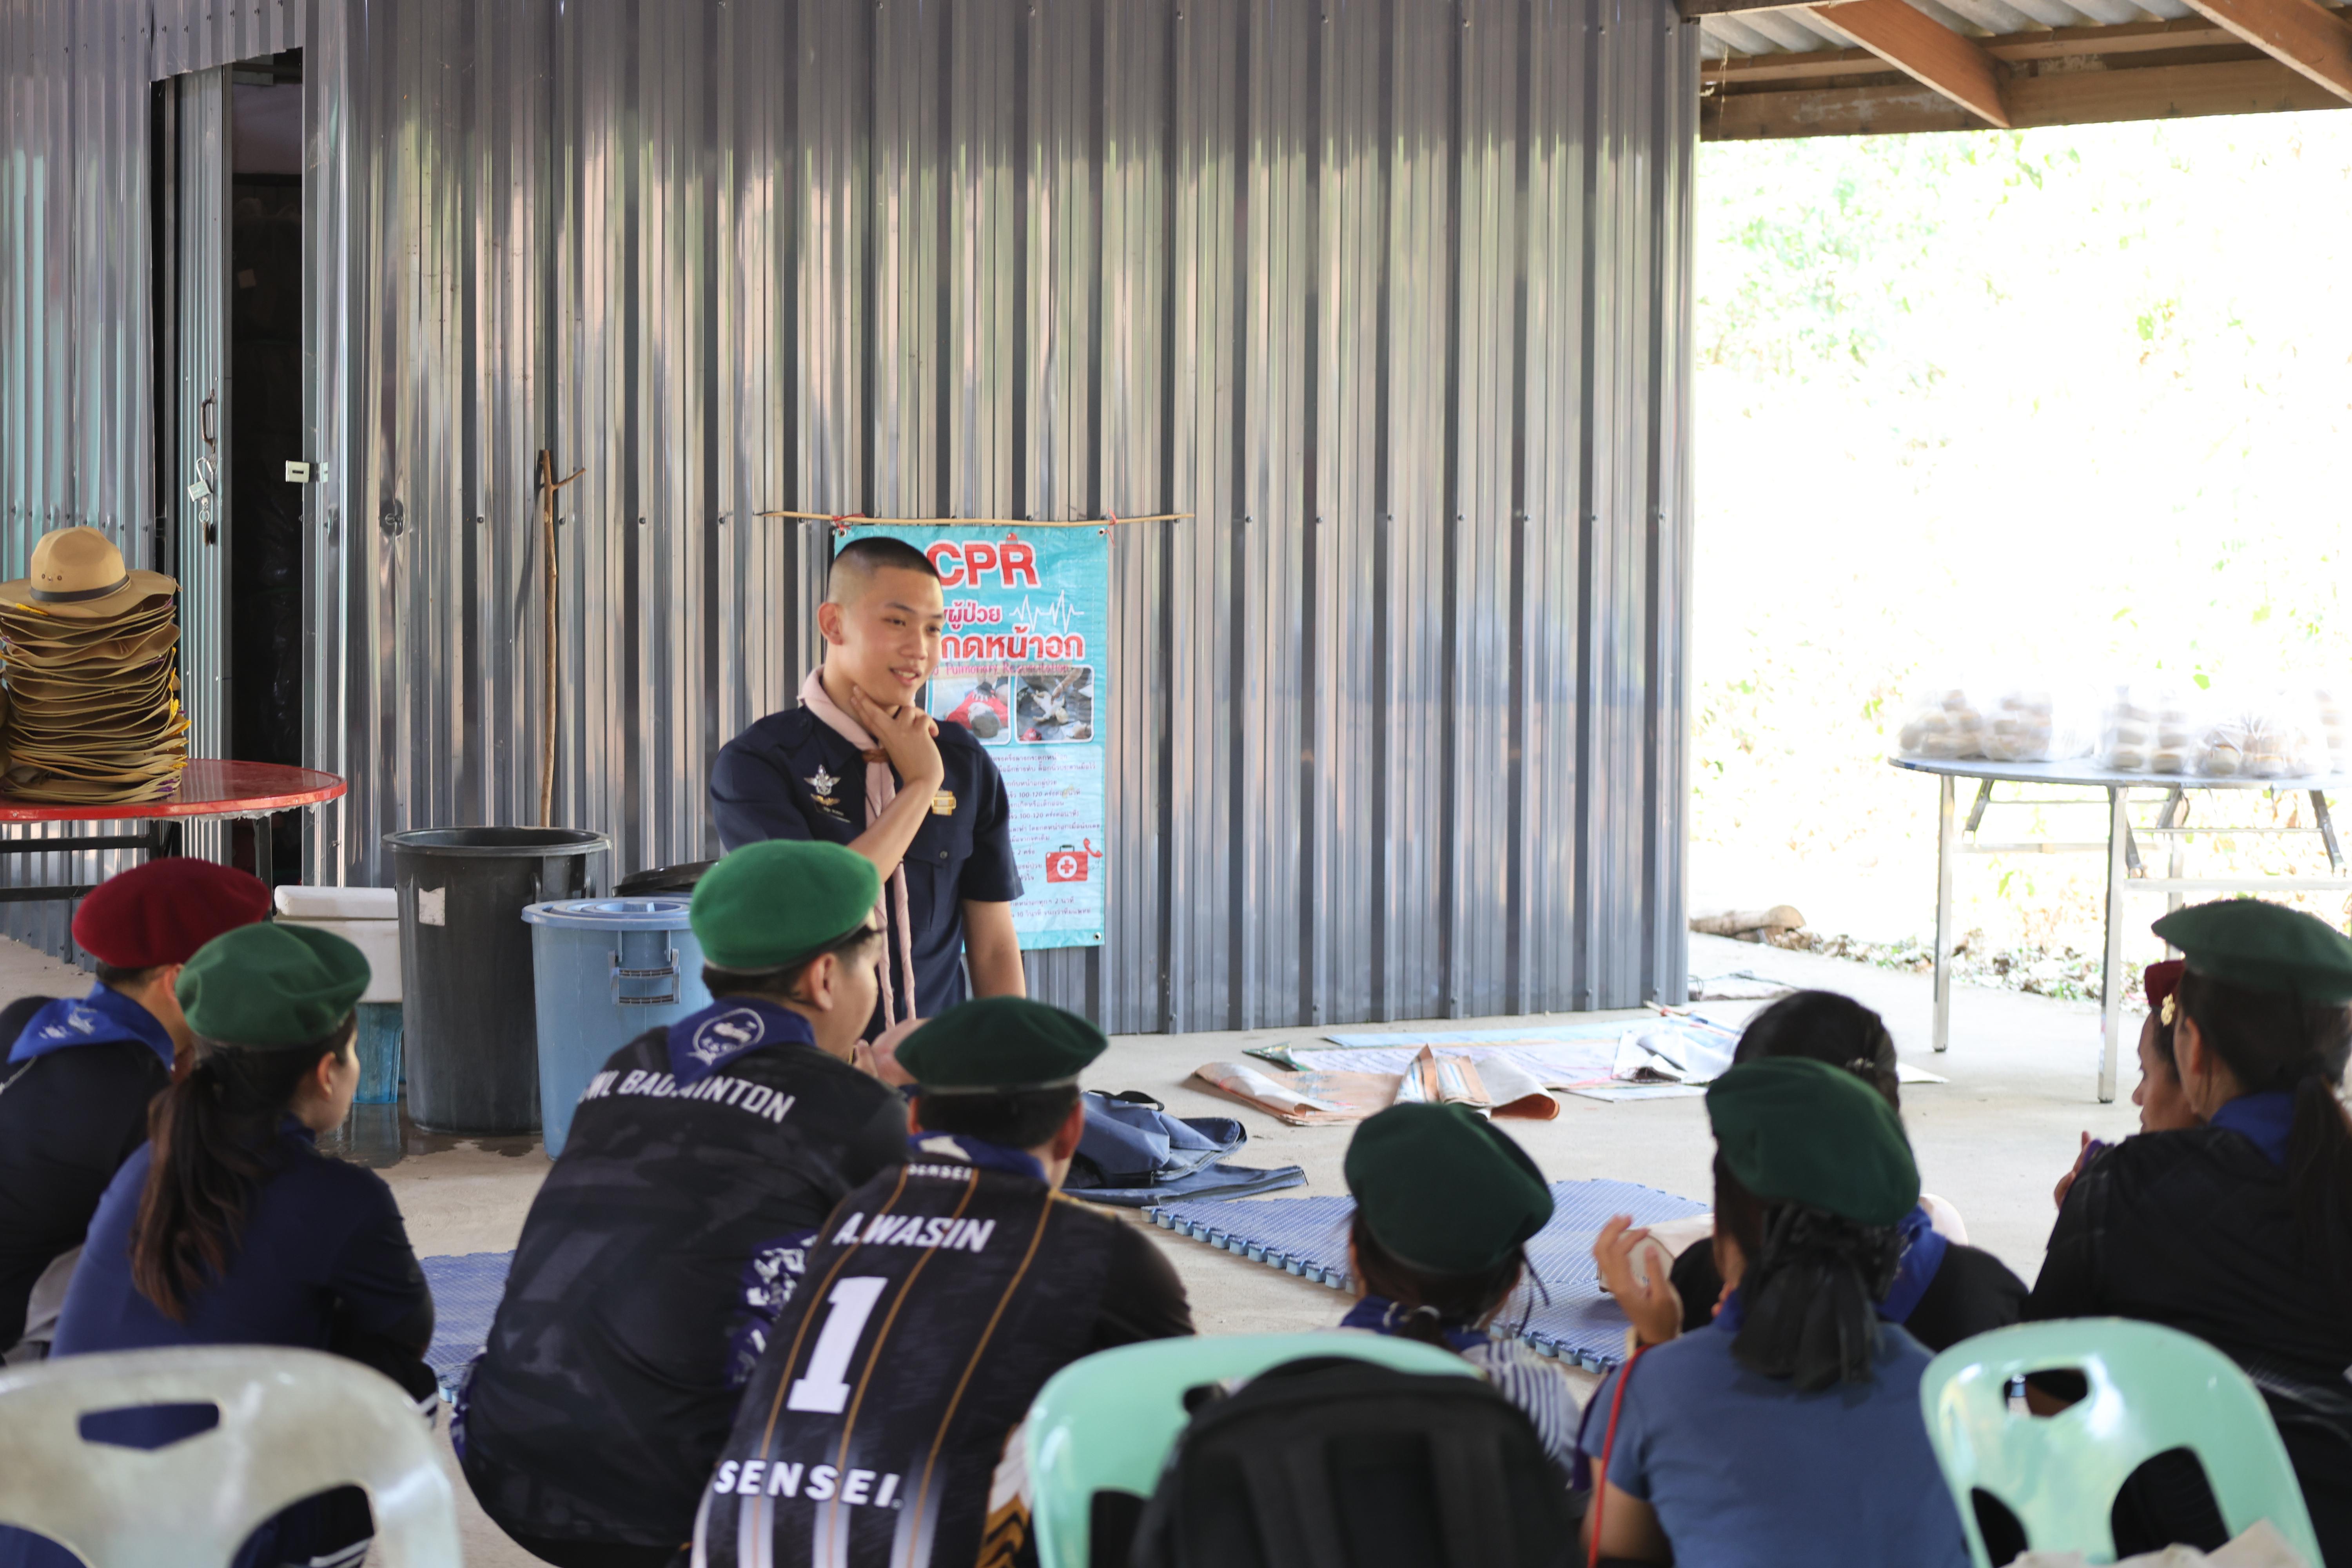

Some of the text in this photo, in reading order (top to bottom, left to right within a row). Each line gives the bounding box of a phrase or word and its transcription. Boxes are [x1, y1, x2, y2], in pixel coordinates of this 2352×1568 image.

[926, 543, 1039, 586] CPR
[941, 625, 1083, 659] กดหน้าอก
[832, 1212, 996, 1253] A.WASIN
[787, 1276, 888, 1414] 1
[713, 1459, 900, 1508] SENSEI
